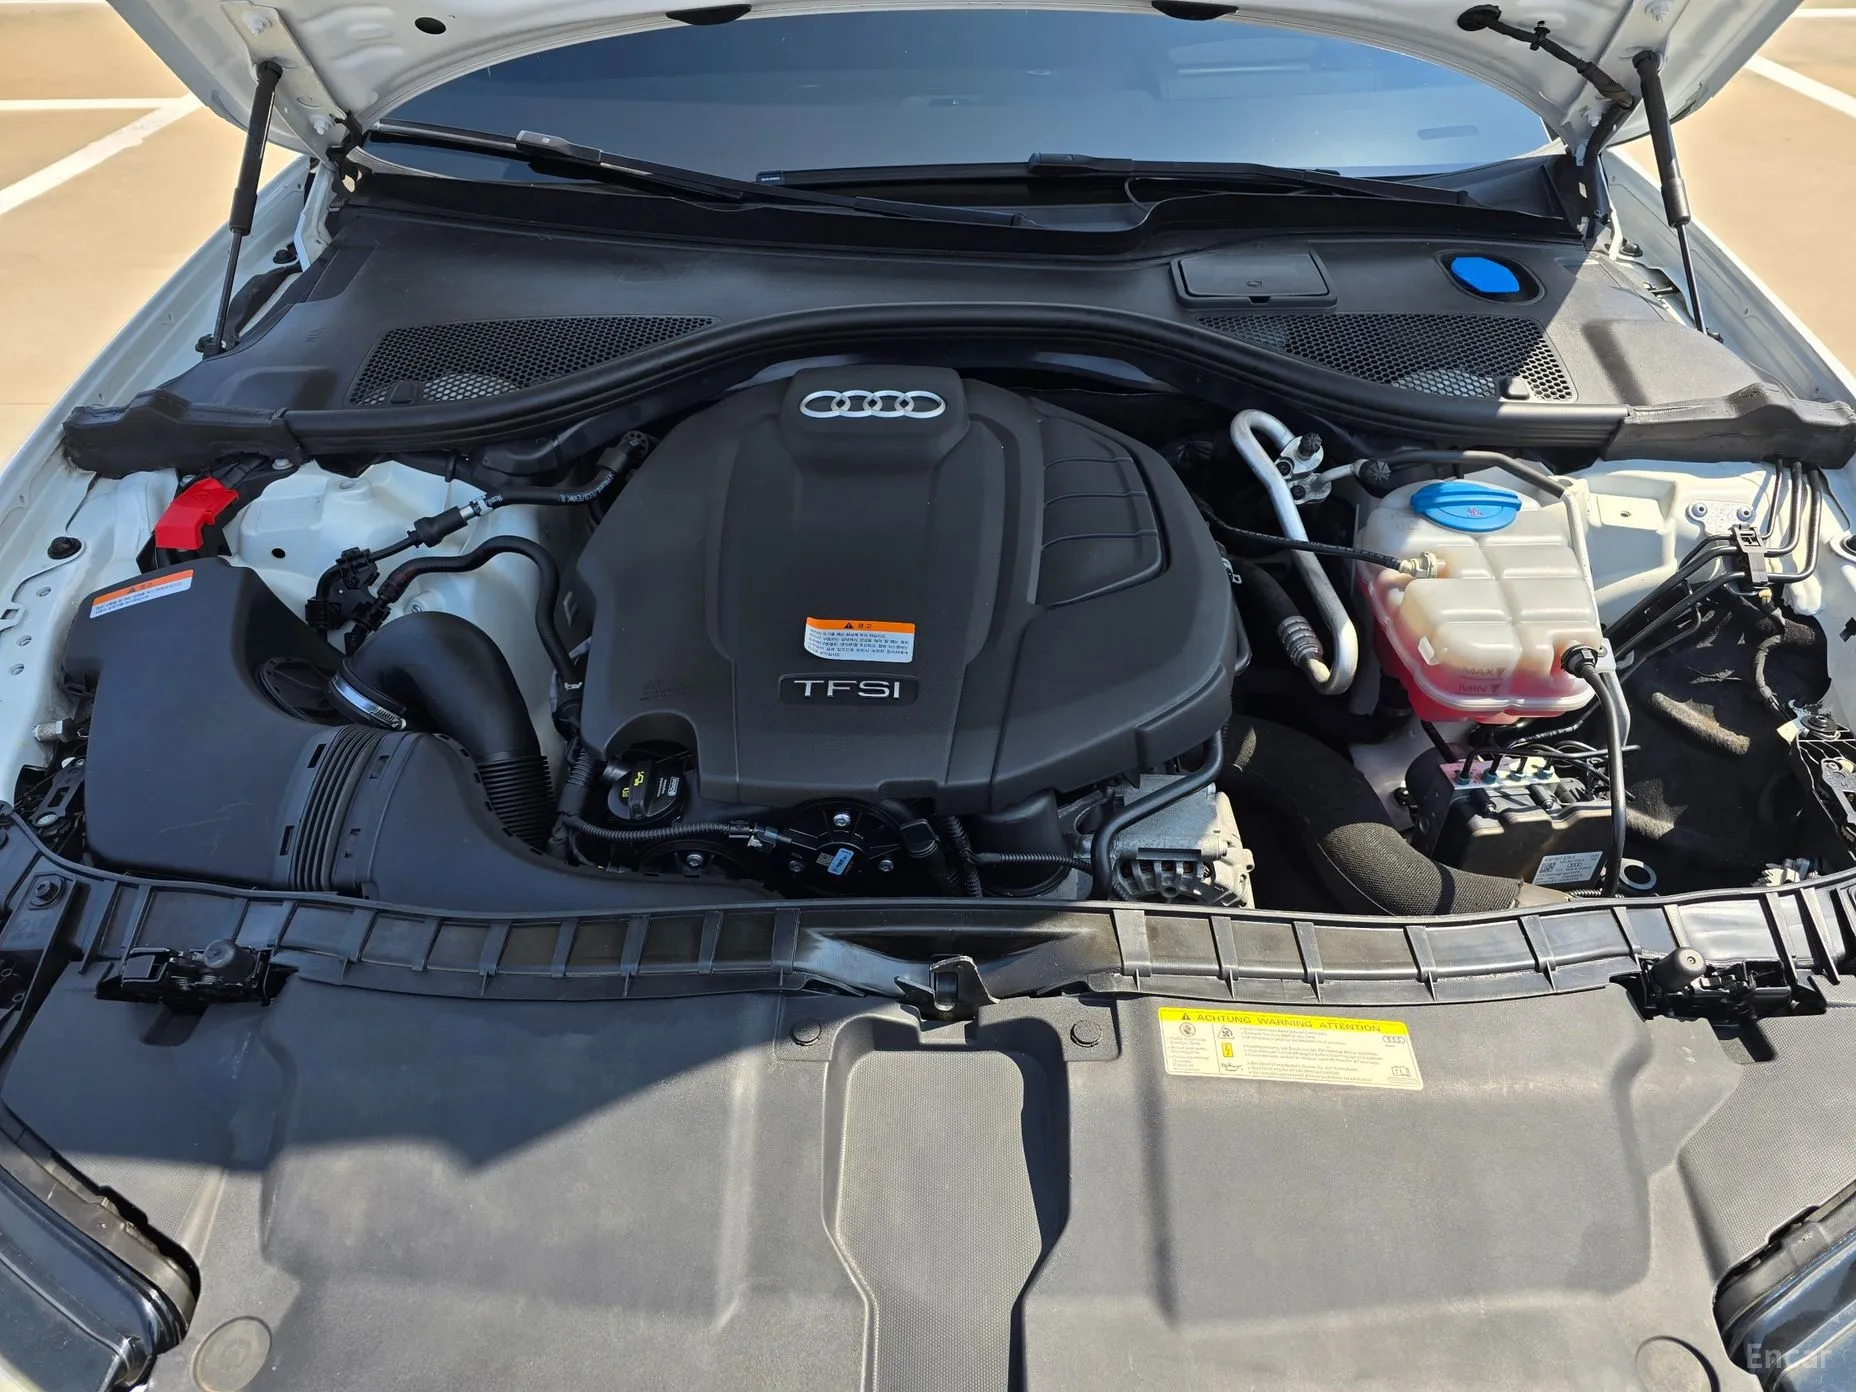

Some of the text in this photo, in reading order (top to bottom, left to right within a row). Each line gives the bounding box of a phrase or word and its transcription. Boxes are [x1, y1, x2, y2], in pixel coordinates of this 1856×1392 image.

[1462, 667, 1494, 677] MAX
[794, 680, 900, 698] TFSI
[1458, 684, 1488, 693] MIN
[1197, 1014, 1381, 1032] ACHTUNG WARNING ATTENTION
